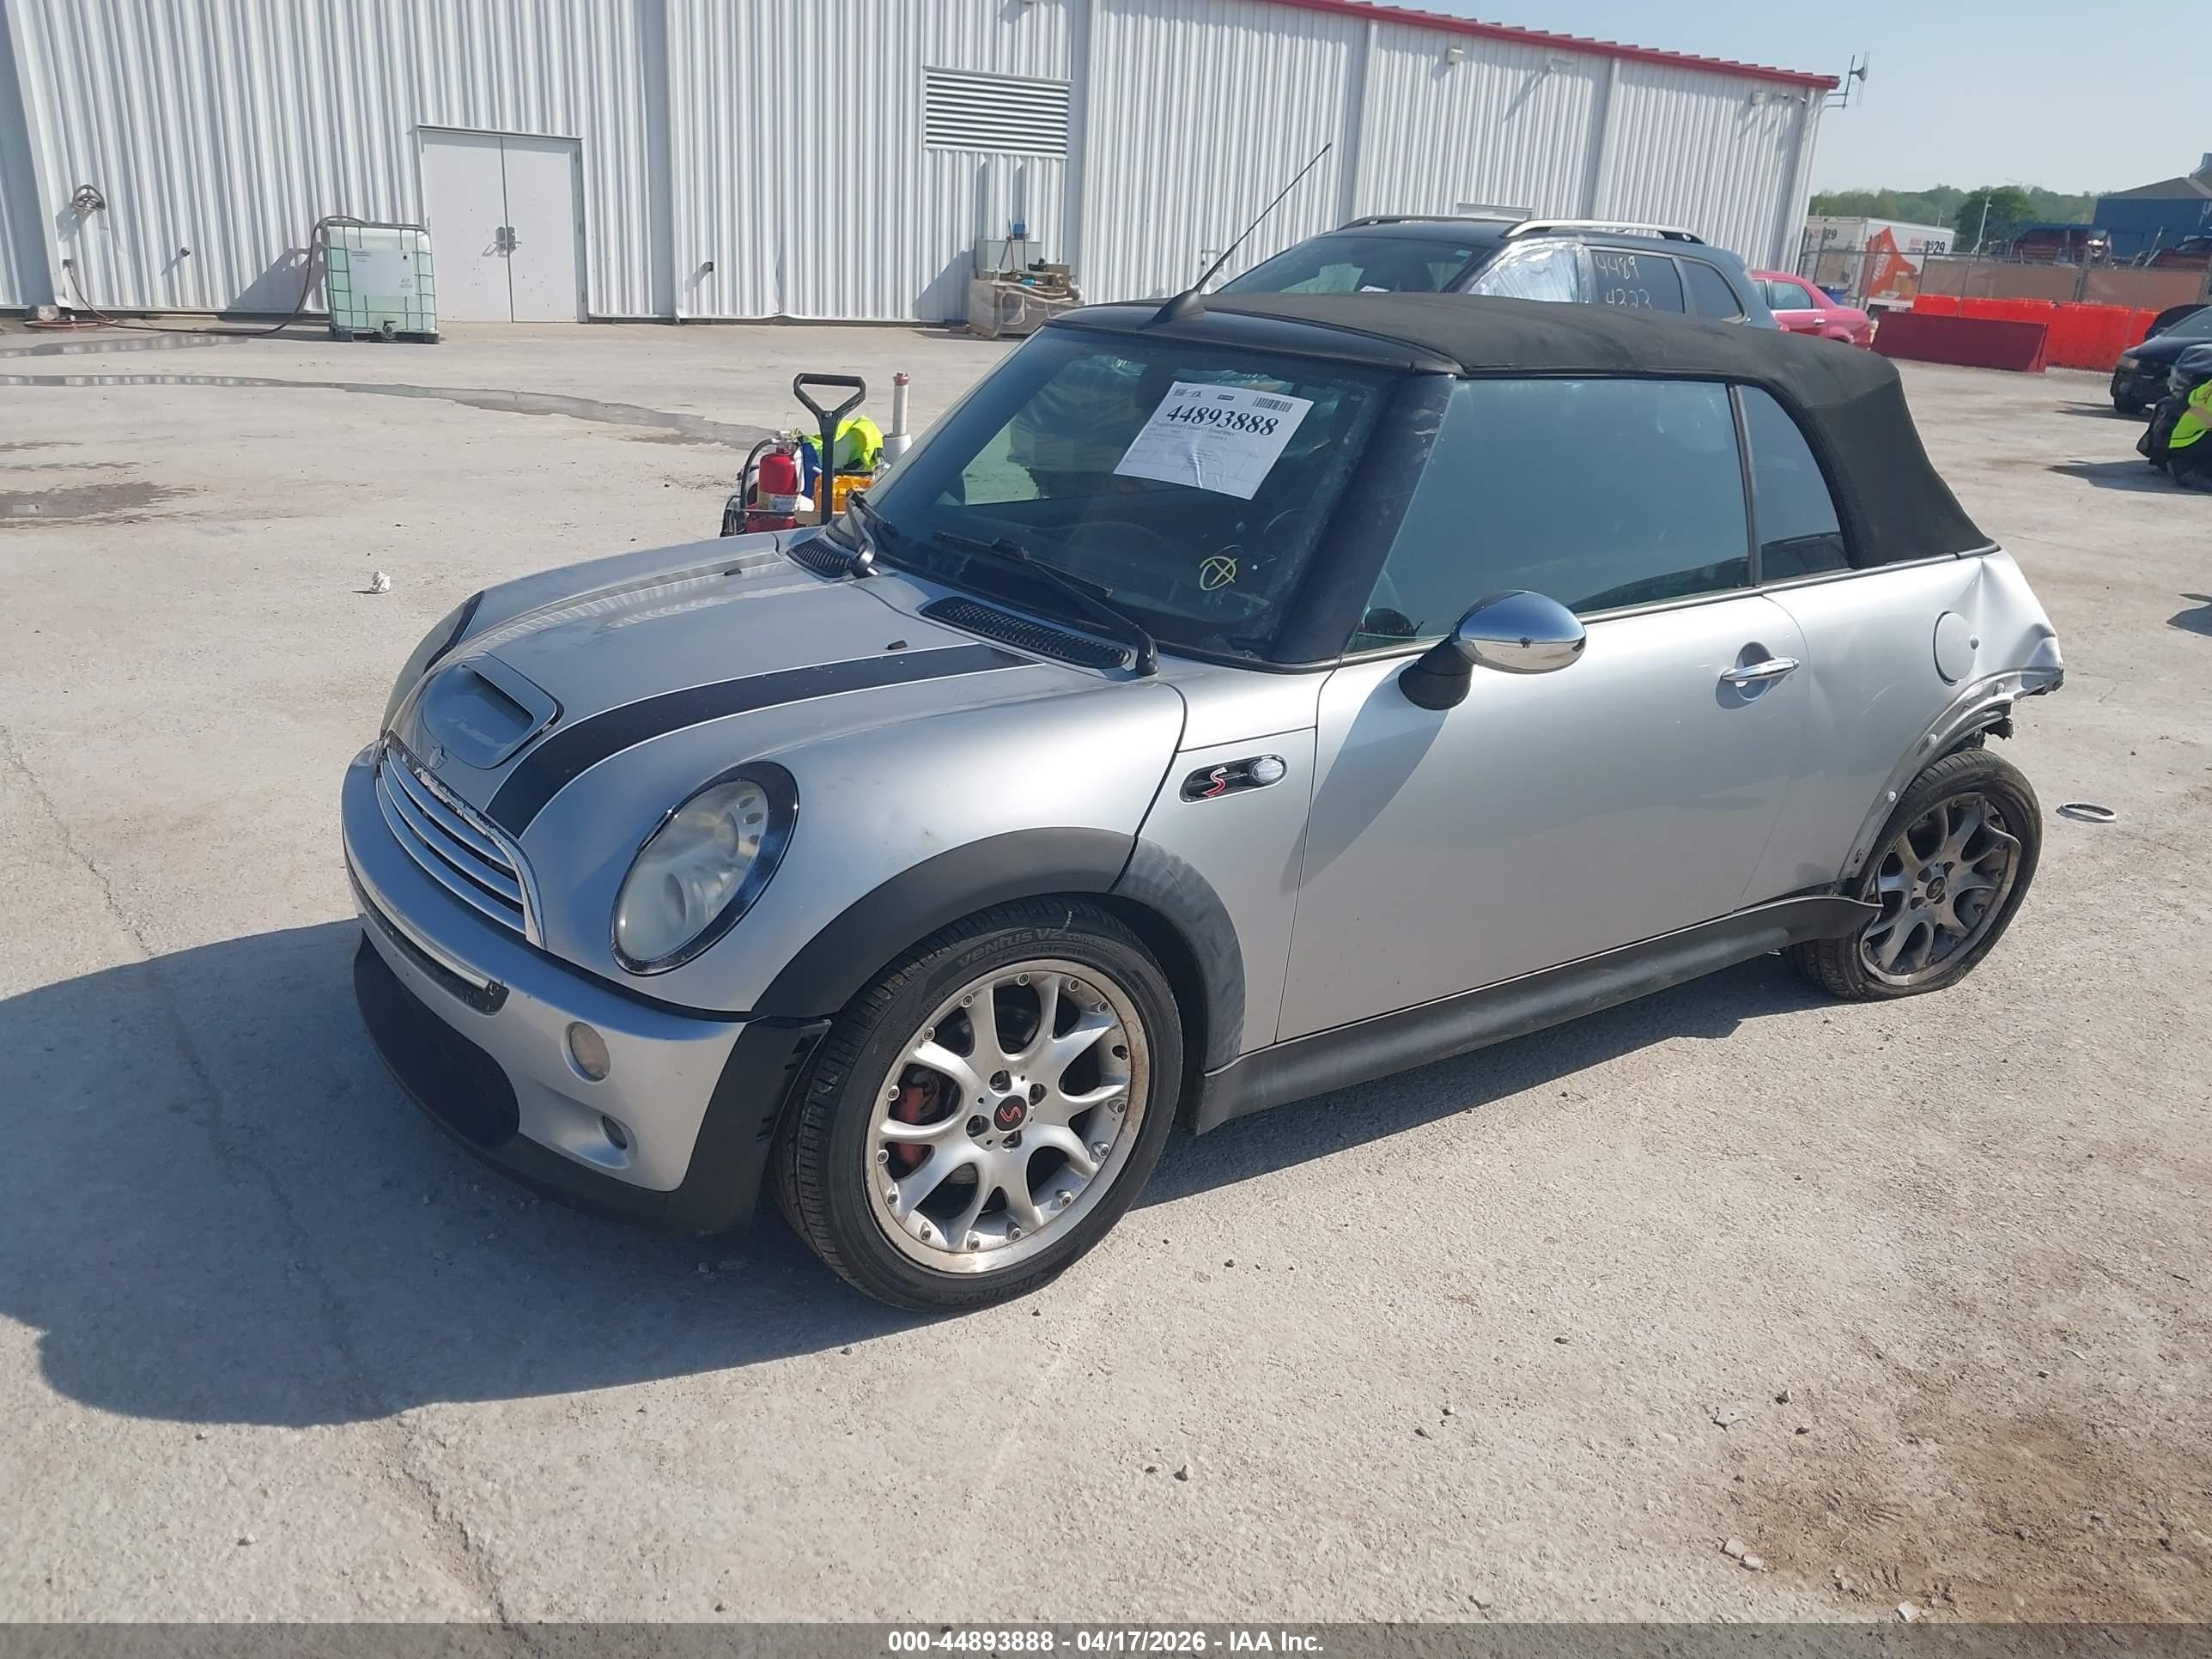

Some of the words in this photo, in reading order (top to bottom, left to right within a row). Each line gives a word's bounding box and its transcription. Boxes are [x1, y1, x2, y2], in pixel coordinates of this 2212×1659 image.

[1595, 254, 1639, 280] 4489
[1166, 404, 1279, 436] 44893888
[1202, 766, 1228, 798] S
